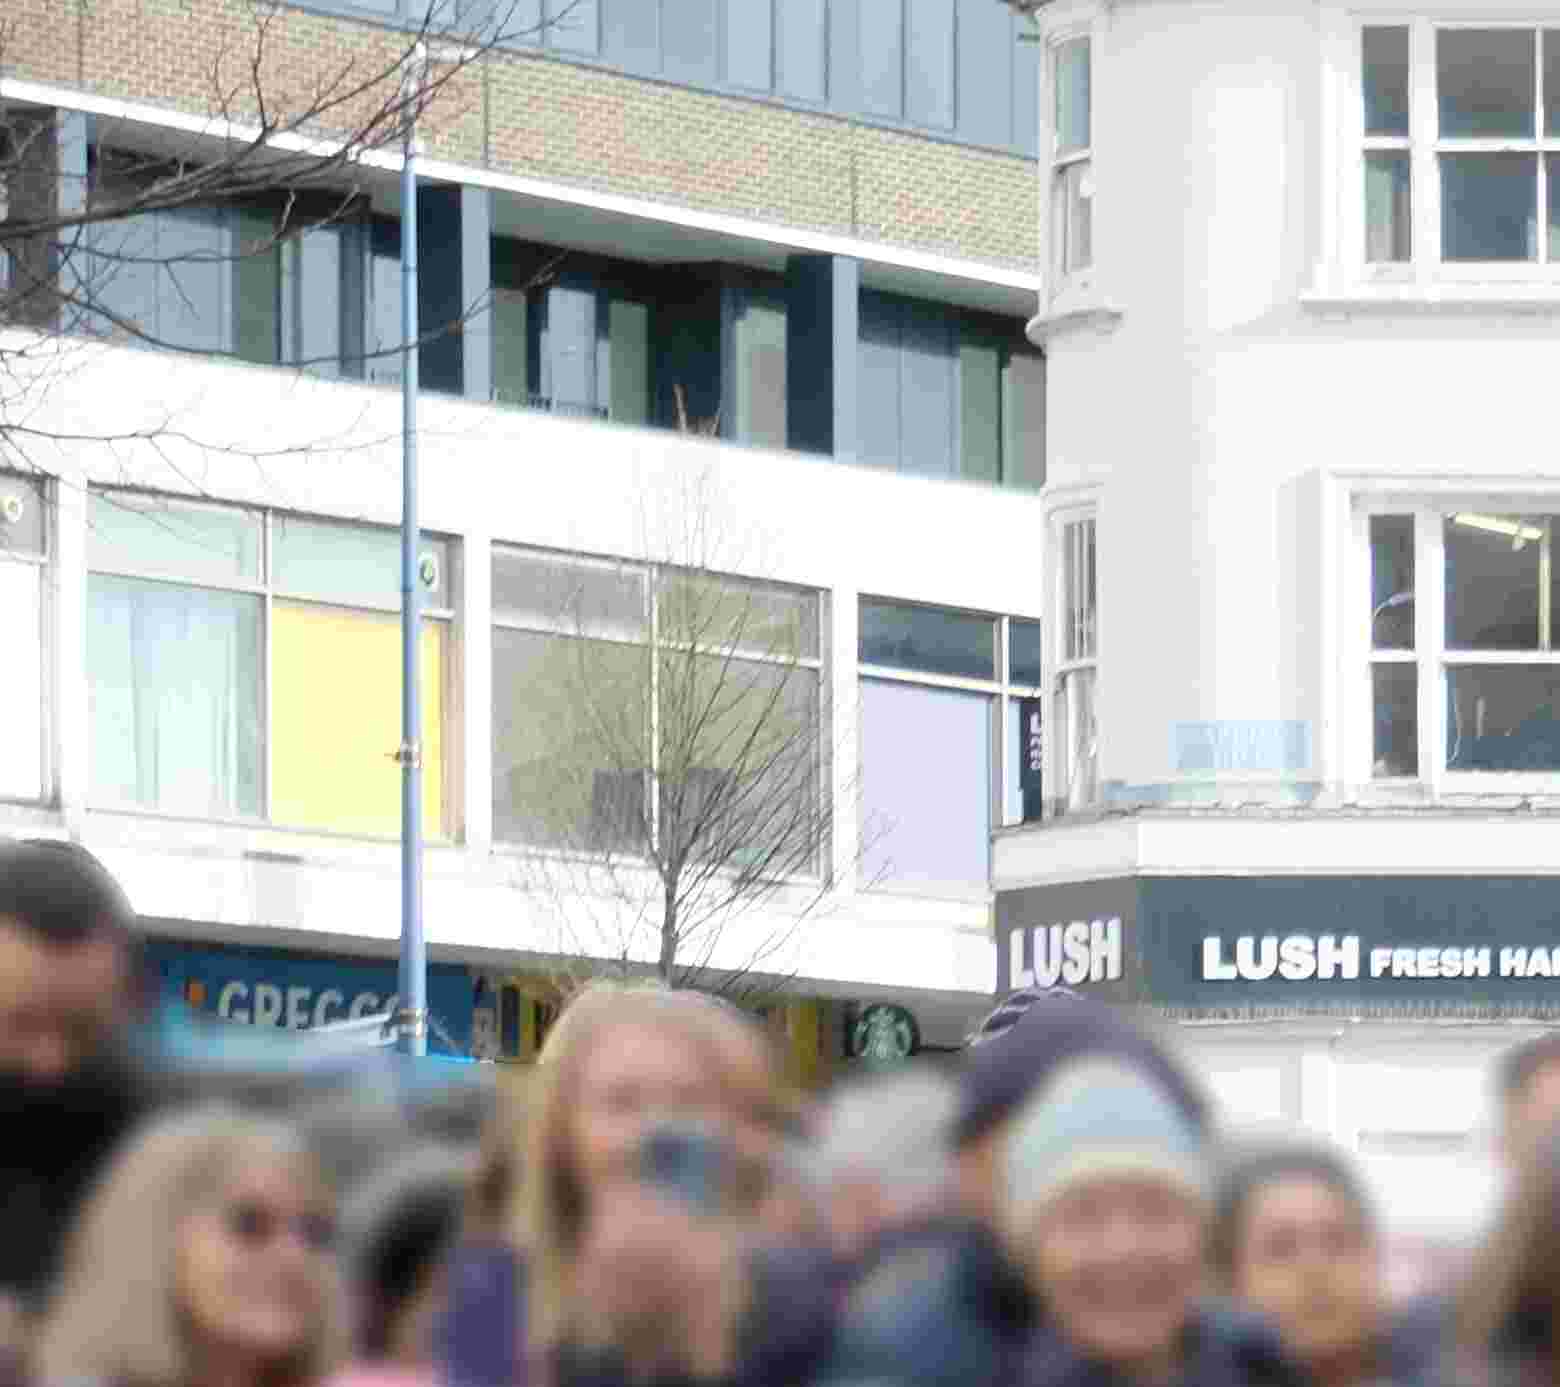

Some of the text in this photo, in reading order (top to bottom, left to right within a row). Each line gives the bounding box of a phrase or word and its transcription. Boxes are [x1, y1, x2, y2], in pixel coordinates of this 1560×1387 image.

[1009, 917, 1122, 991] LUSH
[1202, 934, 1361, 981] LUSH
[1369, 946, 1491, 978] FRESH
